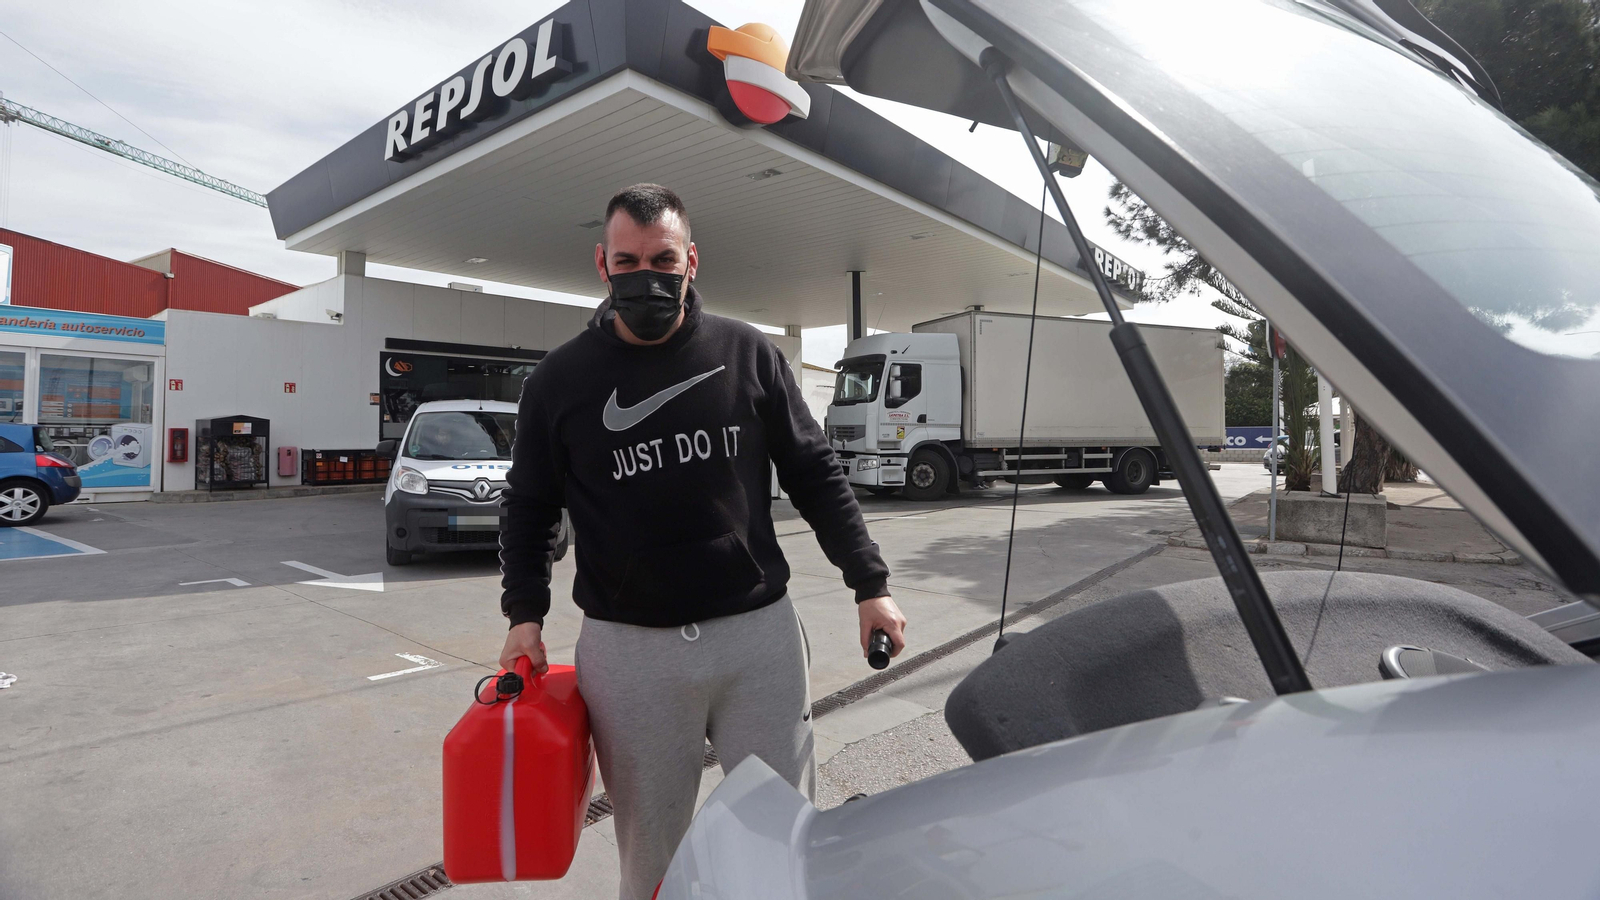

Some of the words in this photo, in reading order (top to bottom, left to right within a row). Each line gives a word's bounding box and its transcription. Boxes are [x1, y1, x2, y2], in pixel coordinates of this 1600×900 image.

[384, 17, 557, 161] REPSOL
[60, 321, 145, 338] autoservicio
[612, 438, 663, 481] JUST
[675, 429, 711, 463] DO
[722, 425, 741, 458] IT
